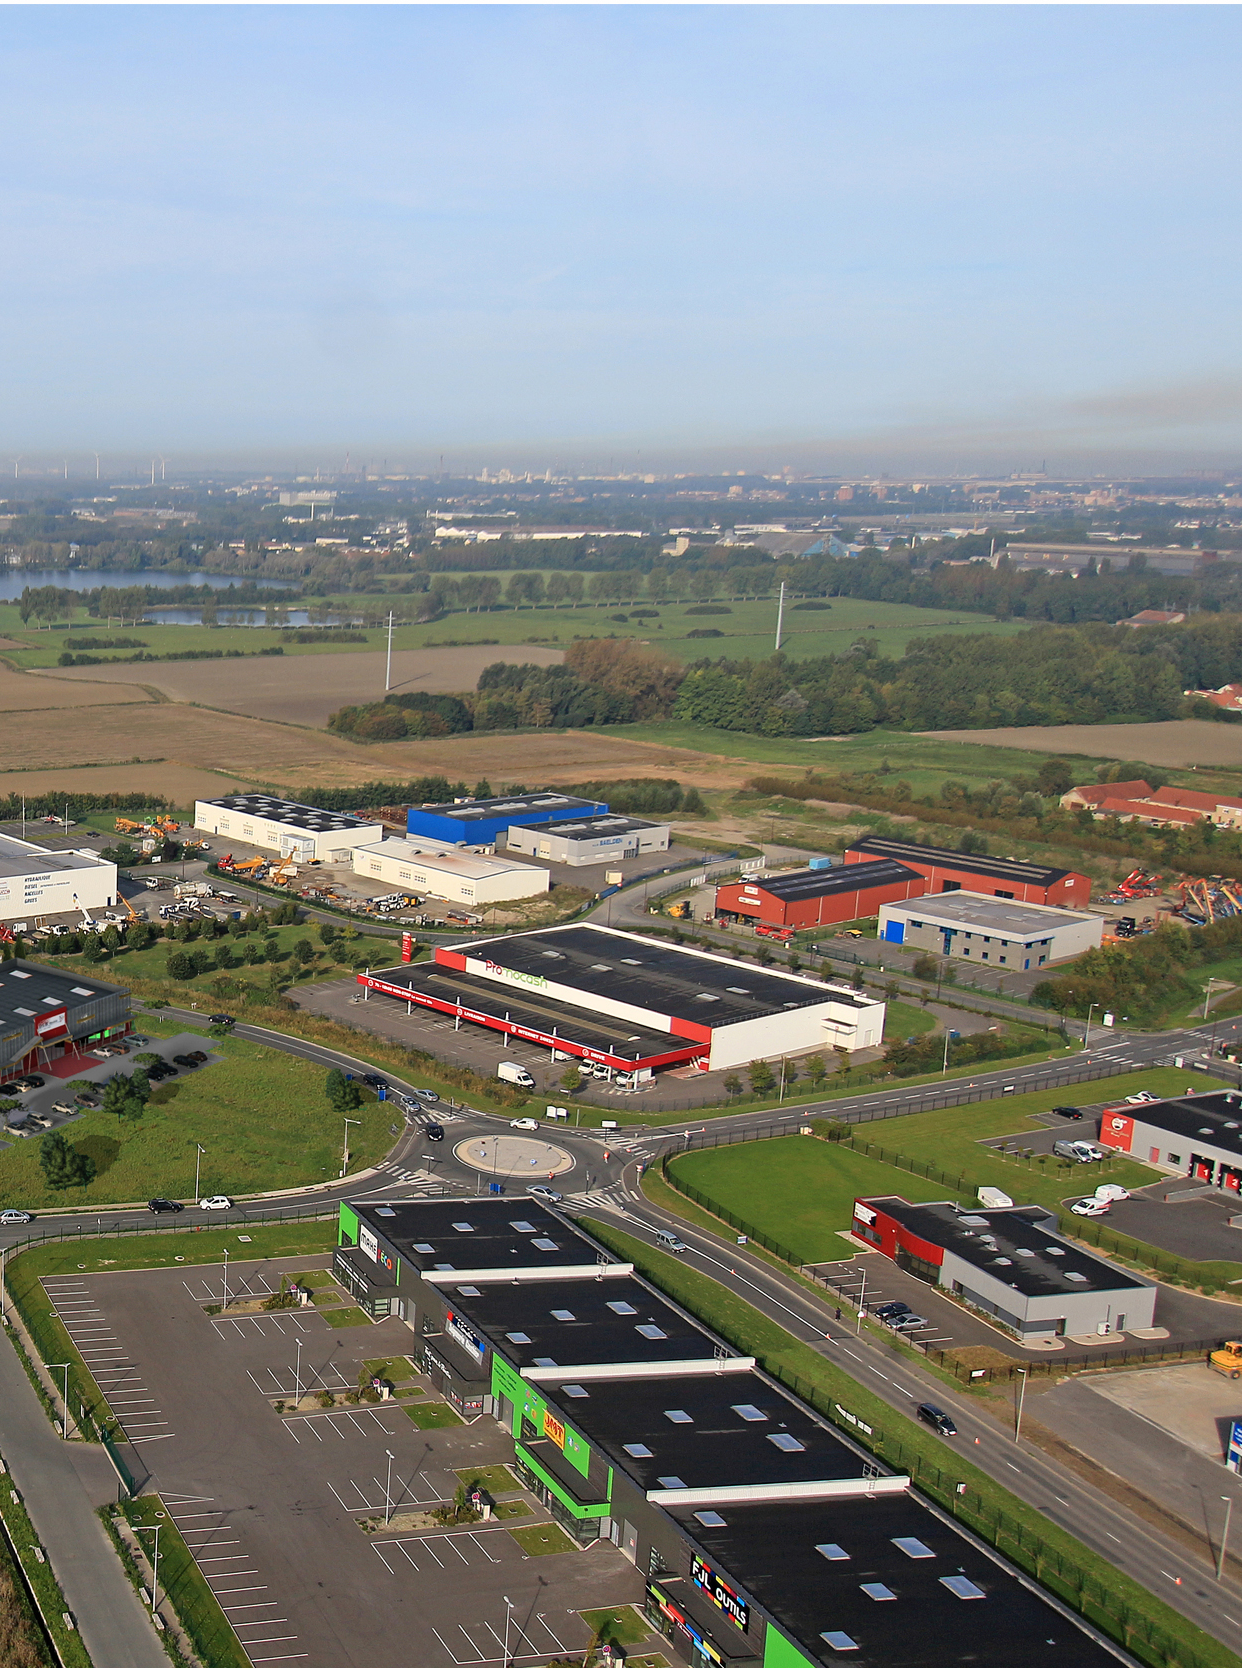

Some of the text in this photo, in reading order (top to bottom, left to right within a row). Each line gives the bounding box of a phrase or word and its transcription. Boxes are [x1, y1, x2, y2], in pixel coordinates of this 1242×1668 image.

[485, 960, 547, 989] Promocash
[590, 1052, 605, 1060] DRIVE
[1232, 1179, 1238, 1187] 2
[692, 1561, 747, 1625] FJL OUTILS
